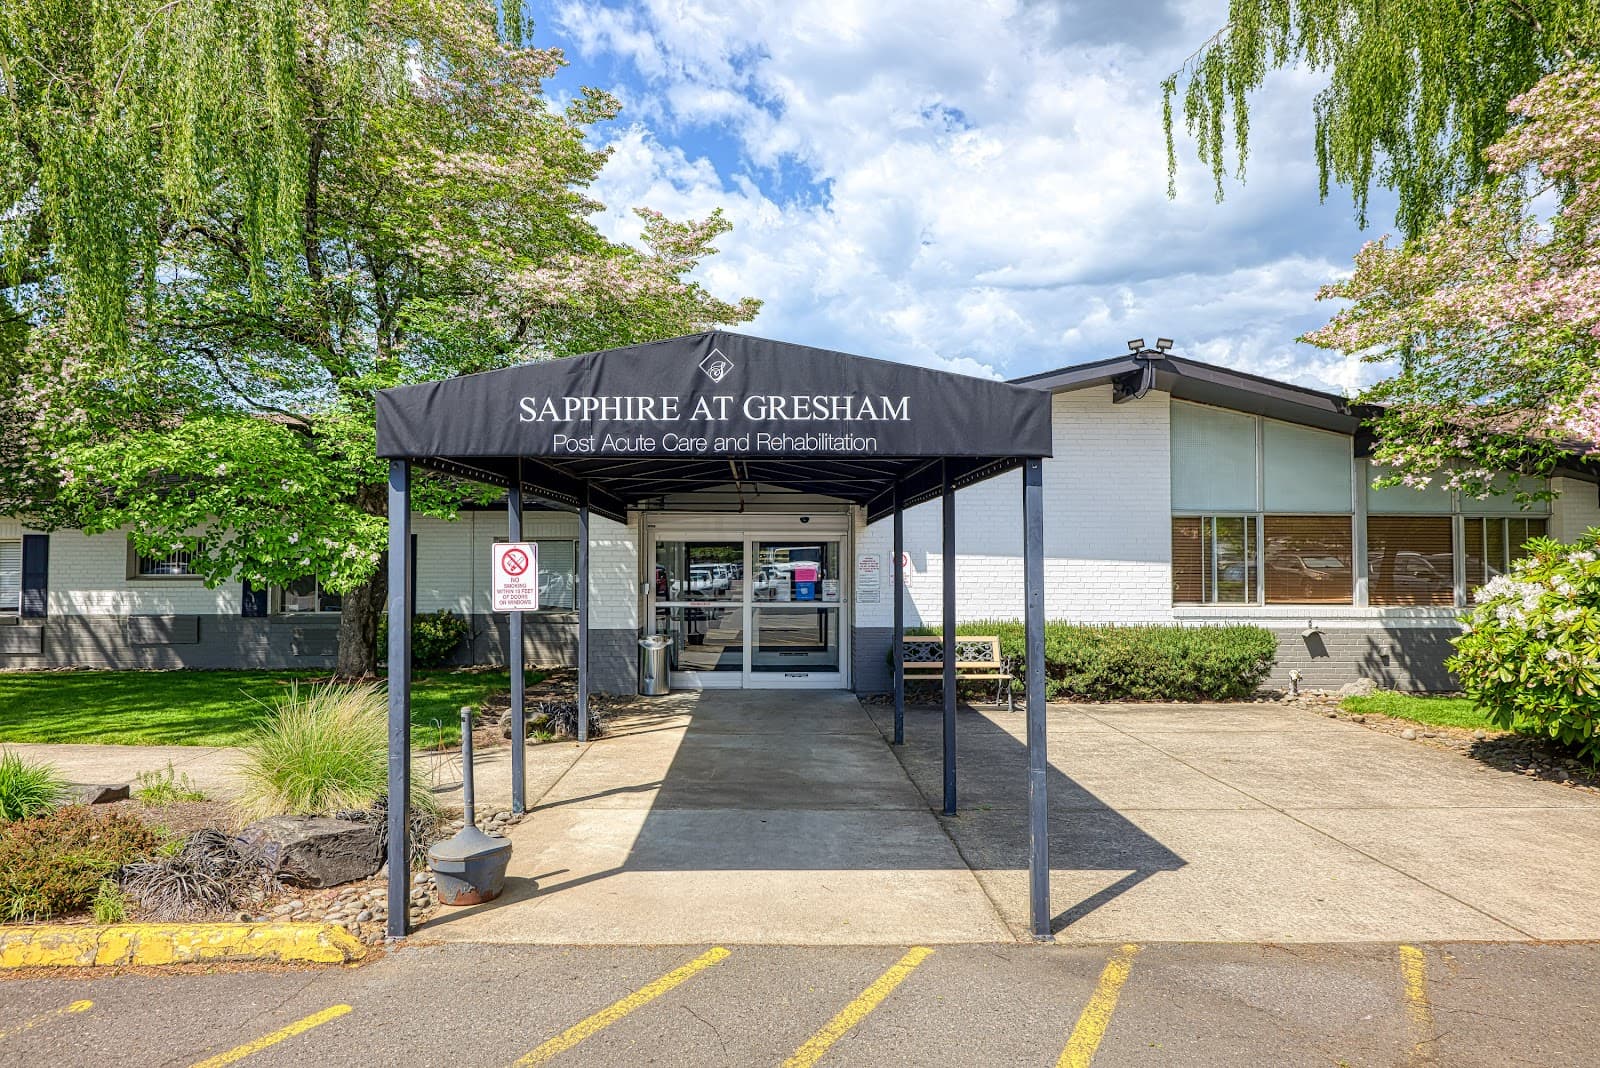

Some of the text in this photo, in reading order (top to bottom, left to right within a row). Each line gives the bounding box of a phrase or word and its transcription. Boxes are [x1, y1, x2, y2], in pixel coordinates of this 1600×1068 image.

[519, 395, 912, 423] SAPPHIRE AT GRESHAM
[553, 432, 877, 453] Post Acute Care and Rehabilitation
